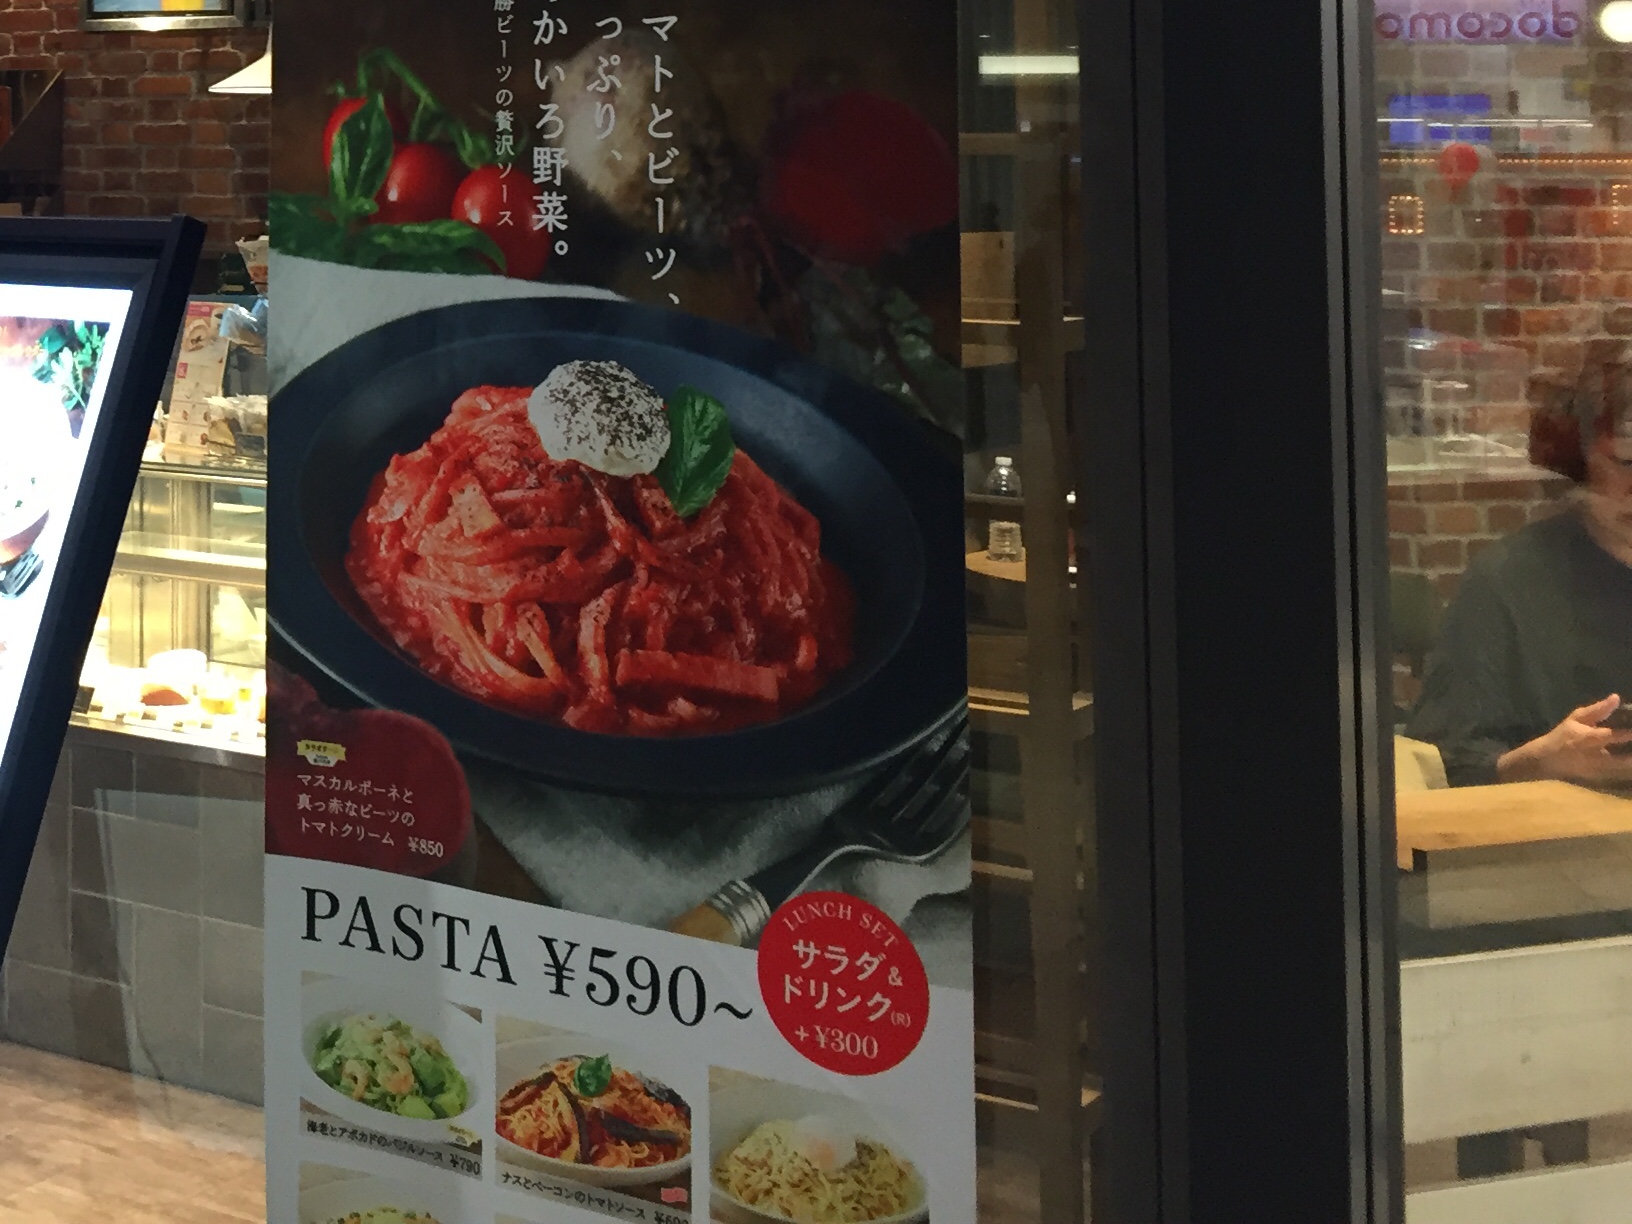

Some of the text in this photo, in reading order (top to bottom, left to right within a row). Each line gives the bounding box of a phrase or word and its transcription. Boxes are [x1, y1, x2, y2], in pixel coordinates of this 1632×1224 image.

[296, 773, 414, 805] マスカルポーネと
[296, 792, 416, 827] 真っ赤なビーツの
[300, 817, 444, 858] トマトクリーム ¥850
[300, 885, 518, 987] PASTA
[783, 901, 899, 947] LUNCH SET
